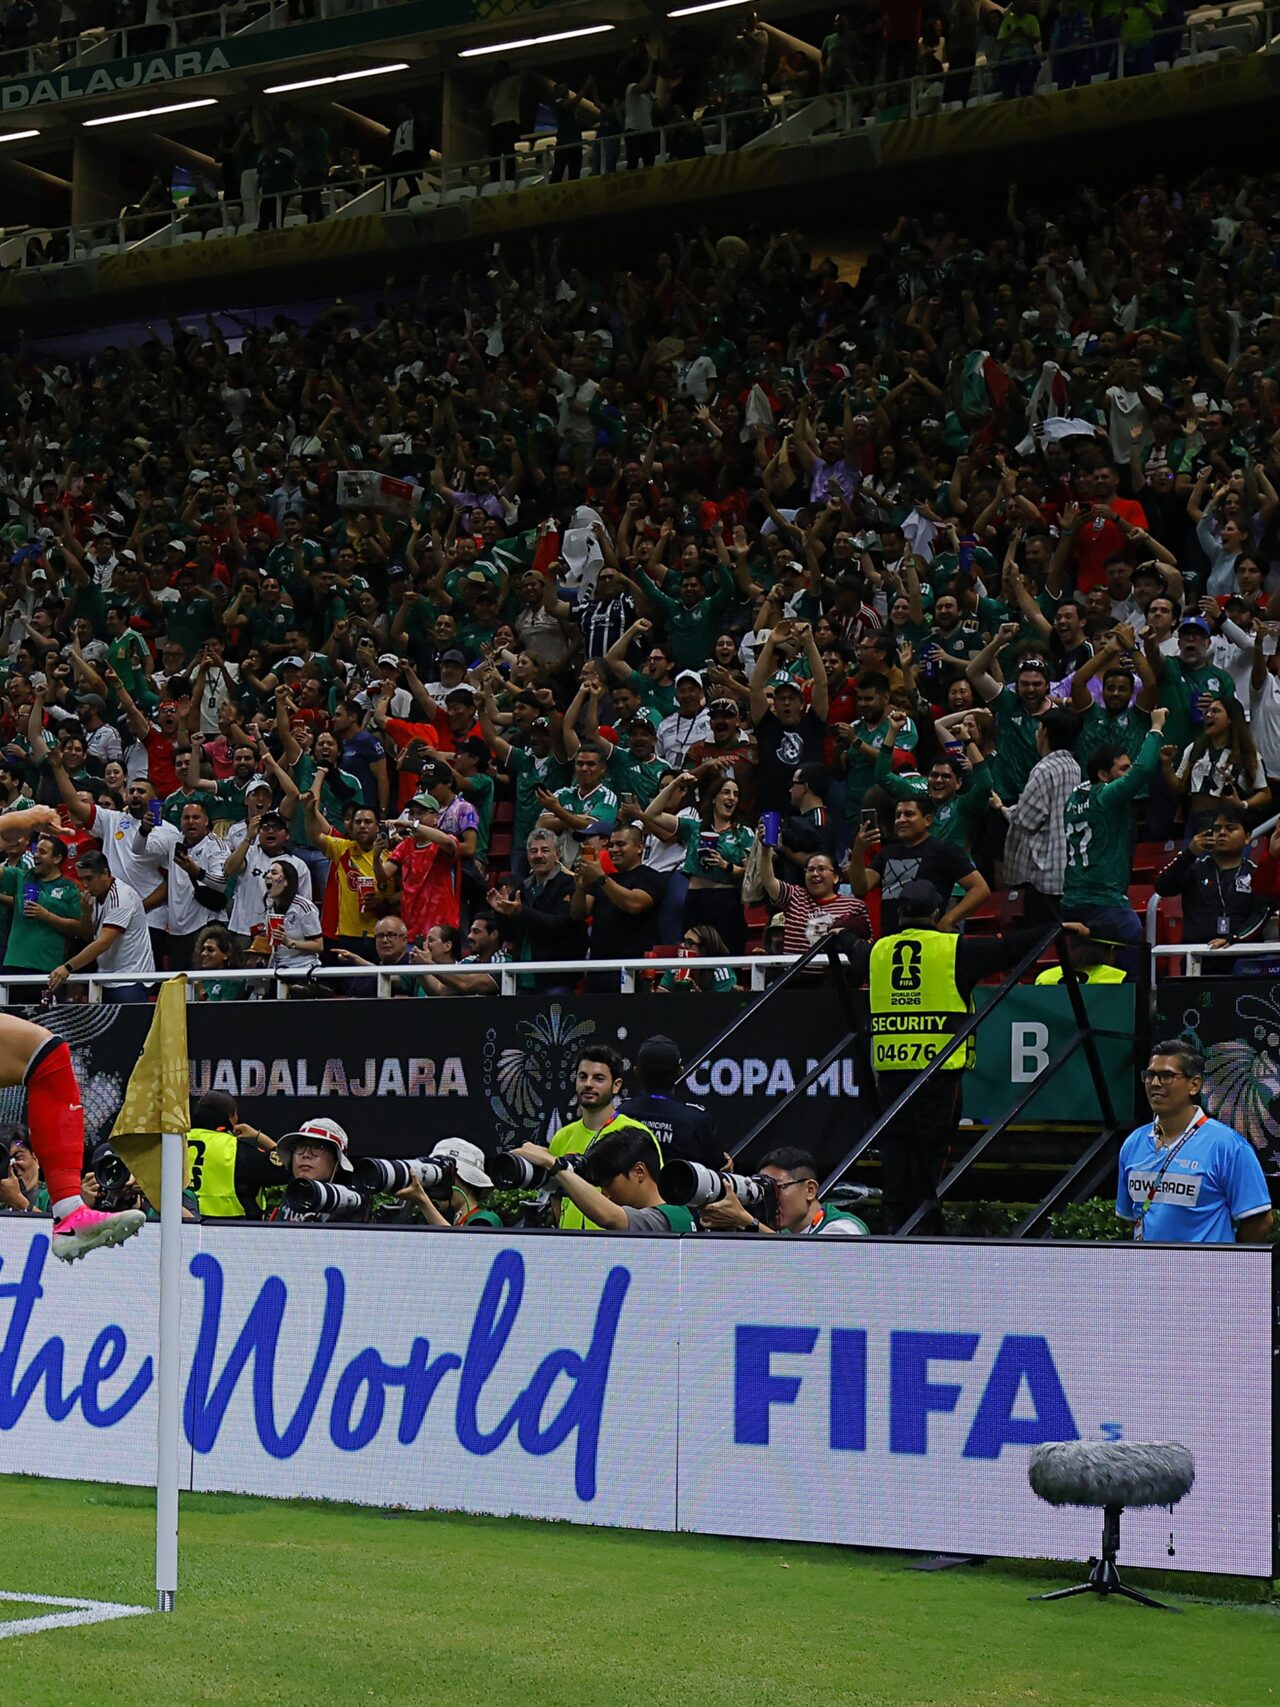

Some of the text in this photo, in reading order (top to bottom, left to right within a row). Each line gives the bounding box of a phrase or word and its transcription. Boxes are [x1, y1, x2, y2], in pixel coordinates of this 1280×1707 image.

[872, 1016, 947, 1032] SECURITY
[877, 1043, 938, 1062] 04676
[1011, 1021, 1050, 1083] B
[189, 1057, 469, 1097] UADALAJARA
[685, 1057, 796, 1096] COPA
[1129, 1179, 1196, 1196] POWERADE
[184, 1247, 632, 1502] World
[733, 1324, 1082, 1462] FIFA
